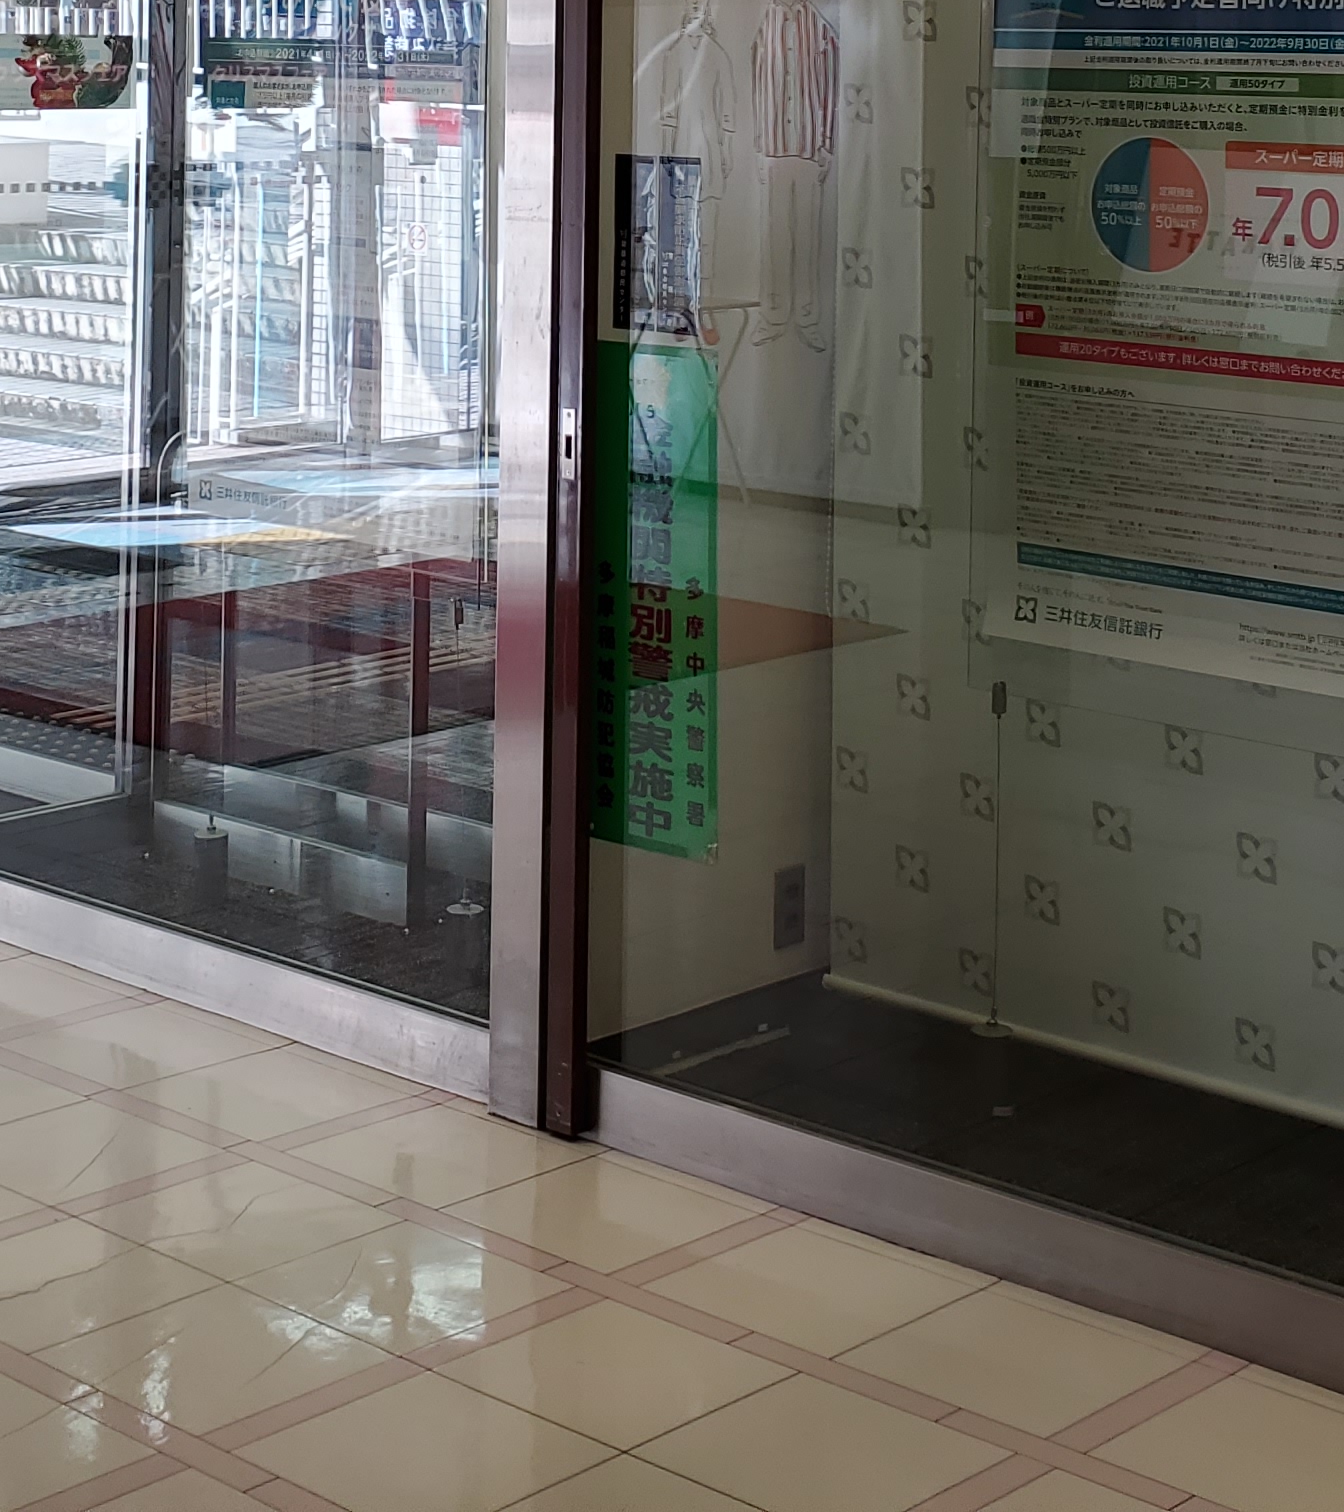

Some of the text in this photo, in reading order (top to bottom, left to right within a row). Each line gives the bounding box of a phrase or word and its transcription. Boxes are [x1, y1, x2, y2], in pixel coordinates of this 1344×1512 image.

[1129, 74, 1286, 90] 投資運用コース 運用50タイプ
[1255, 149, 1344, 168] スーパー定期
[1044, 605, 1164, 640] 三井住友信託銀行
[686, 576, 706, 828] 多摩中央警察署
